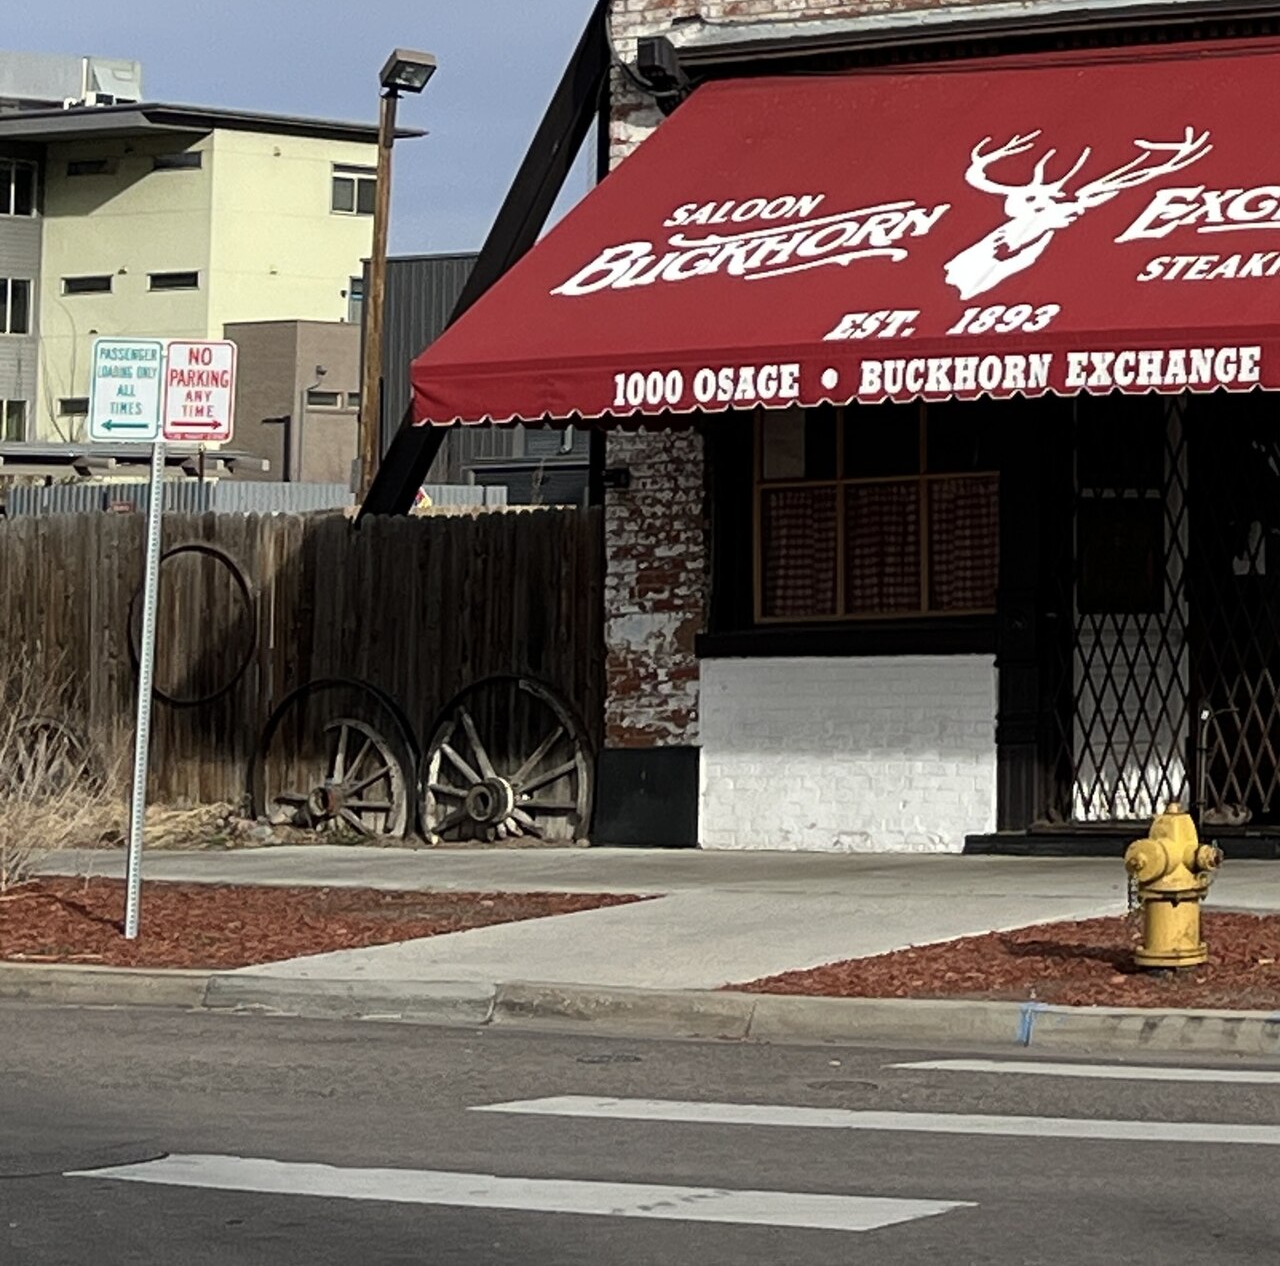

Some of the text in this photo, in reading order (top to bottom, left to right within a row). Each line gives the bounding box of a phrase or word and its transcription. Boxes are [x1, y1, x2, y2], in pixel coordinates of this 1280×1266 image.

[663, 193, 826, 227] SALOON
[549, 203, 951, 297] BUCKHORN
[822, 303, 1061, 341] EST. 1893
[99, 346, 158, 362] PASSENGER
[187, 346, 213, 366] NO
[97, 365, 158, 379] LOADING ONLY
[169, 369, 230, 389] PARKING
[613, 345, 1262, 407] 1000 OSAGE BUCKHORN EXCHANGE
[116, 383, 136, 397] ALL
[185, 390, 213, 403] ANY
[109, 401, 143, 415] TIMES
[181, 404, 214, 418] TIME
